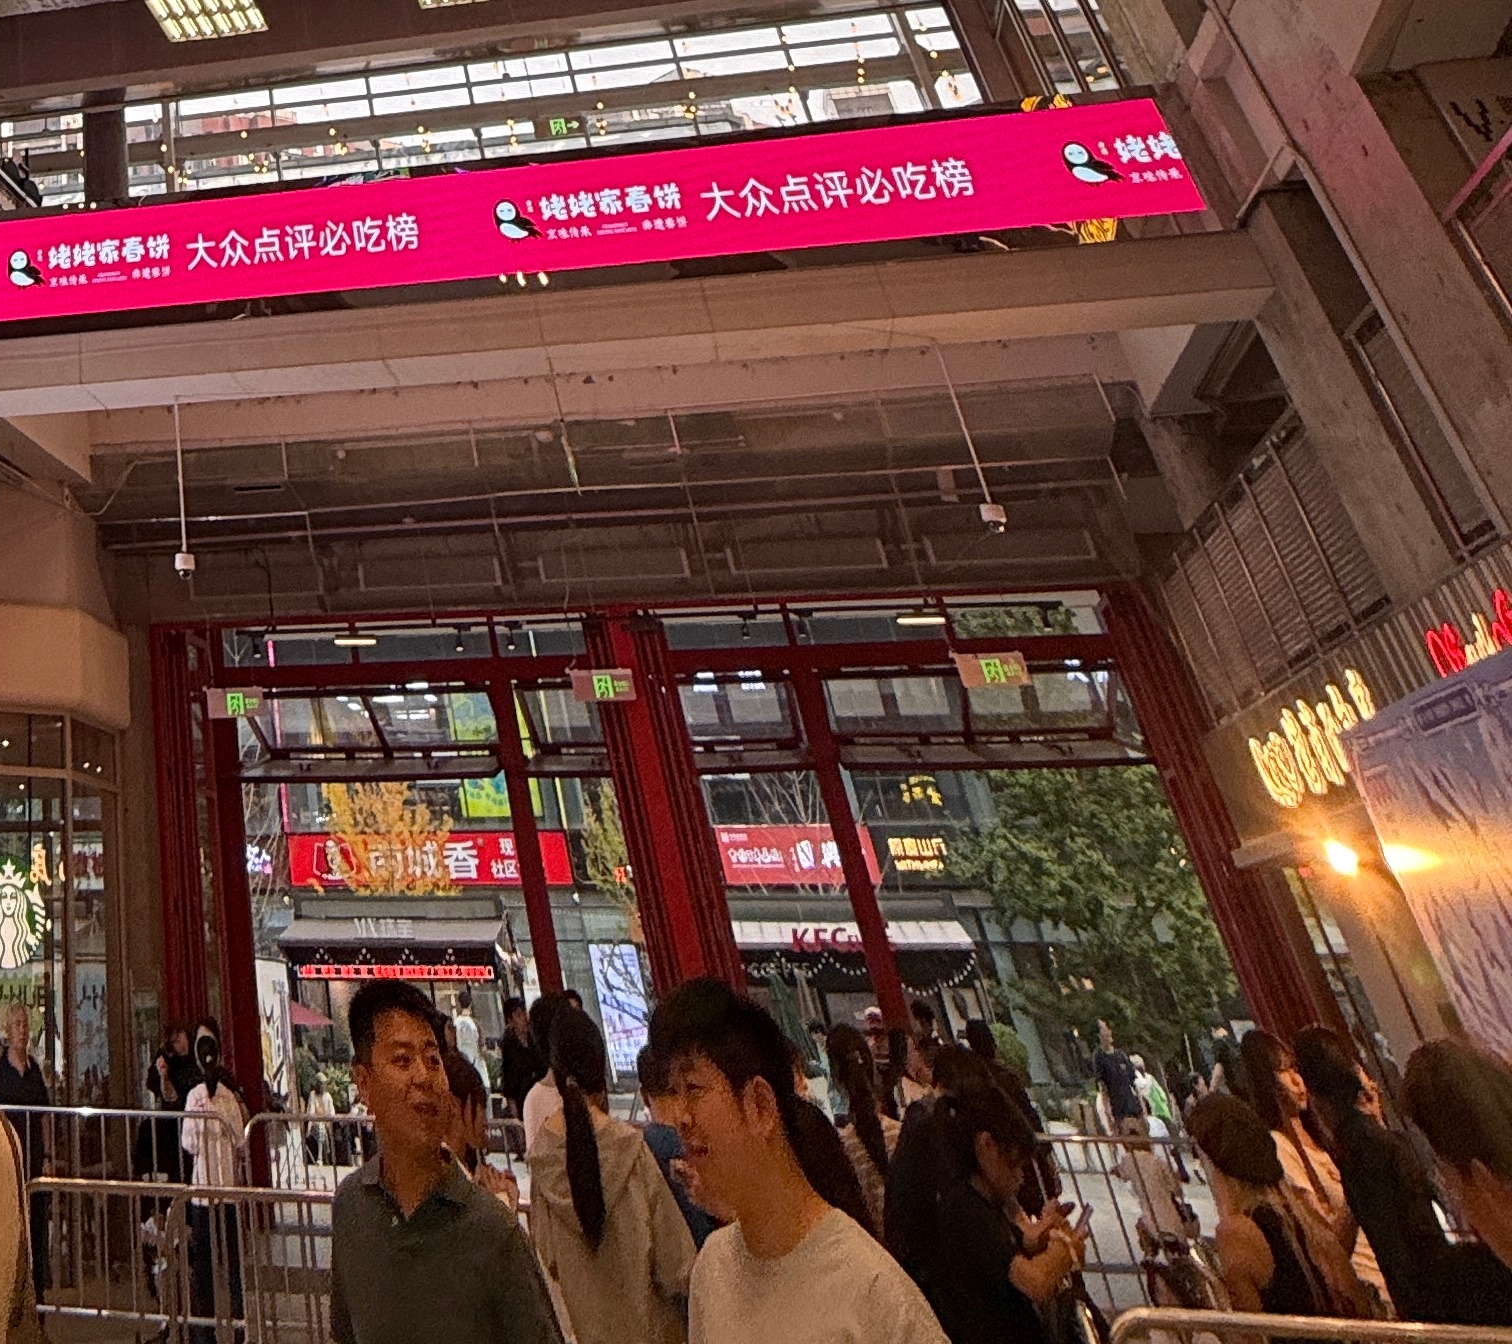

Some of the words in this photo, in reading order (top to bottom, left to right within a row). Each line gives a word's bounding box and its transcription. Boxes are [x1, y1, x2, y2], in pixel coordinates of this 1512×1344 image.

[538, 182, 683, 223] 姥姥家春饼
[699, 156, 975, 223] 大众点评必吃榜
[48, 233, 171, 271] 姥姥家春饼
[186, 211, 420, 271] 大众点评必吃榜
[791, 926, 850, 953] KFC
